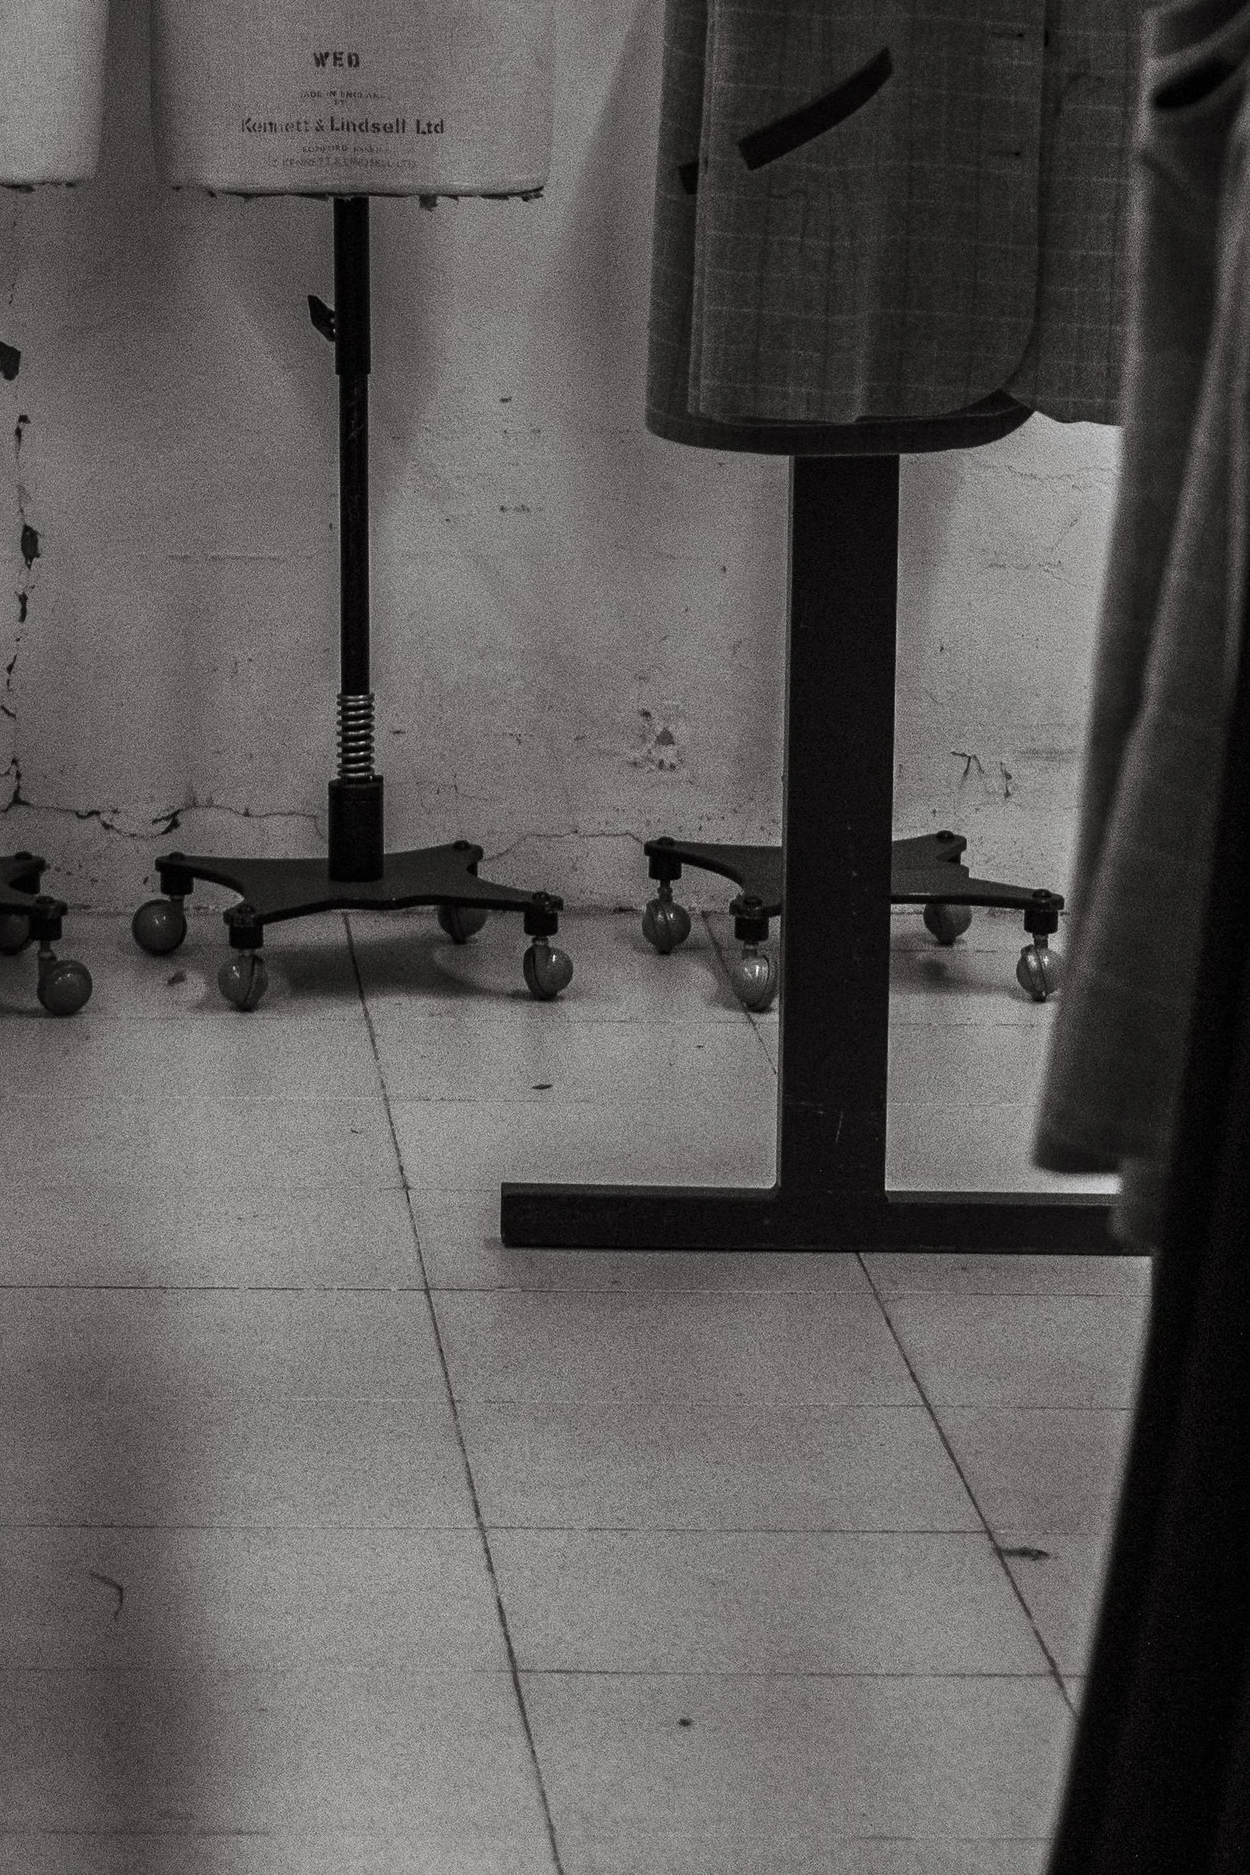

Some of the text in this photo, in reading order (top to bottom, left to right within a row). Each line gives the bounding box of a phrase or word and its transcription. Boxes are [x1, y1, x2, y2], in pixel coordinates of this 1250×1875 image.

[242, 116, 445, 135] Kennett & Lindsell Ltd
